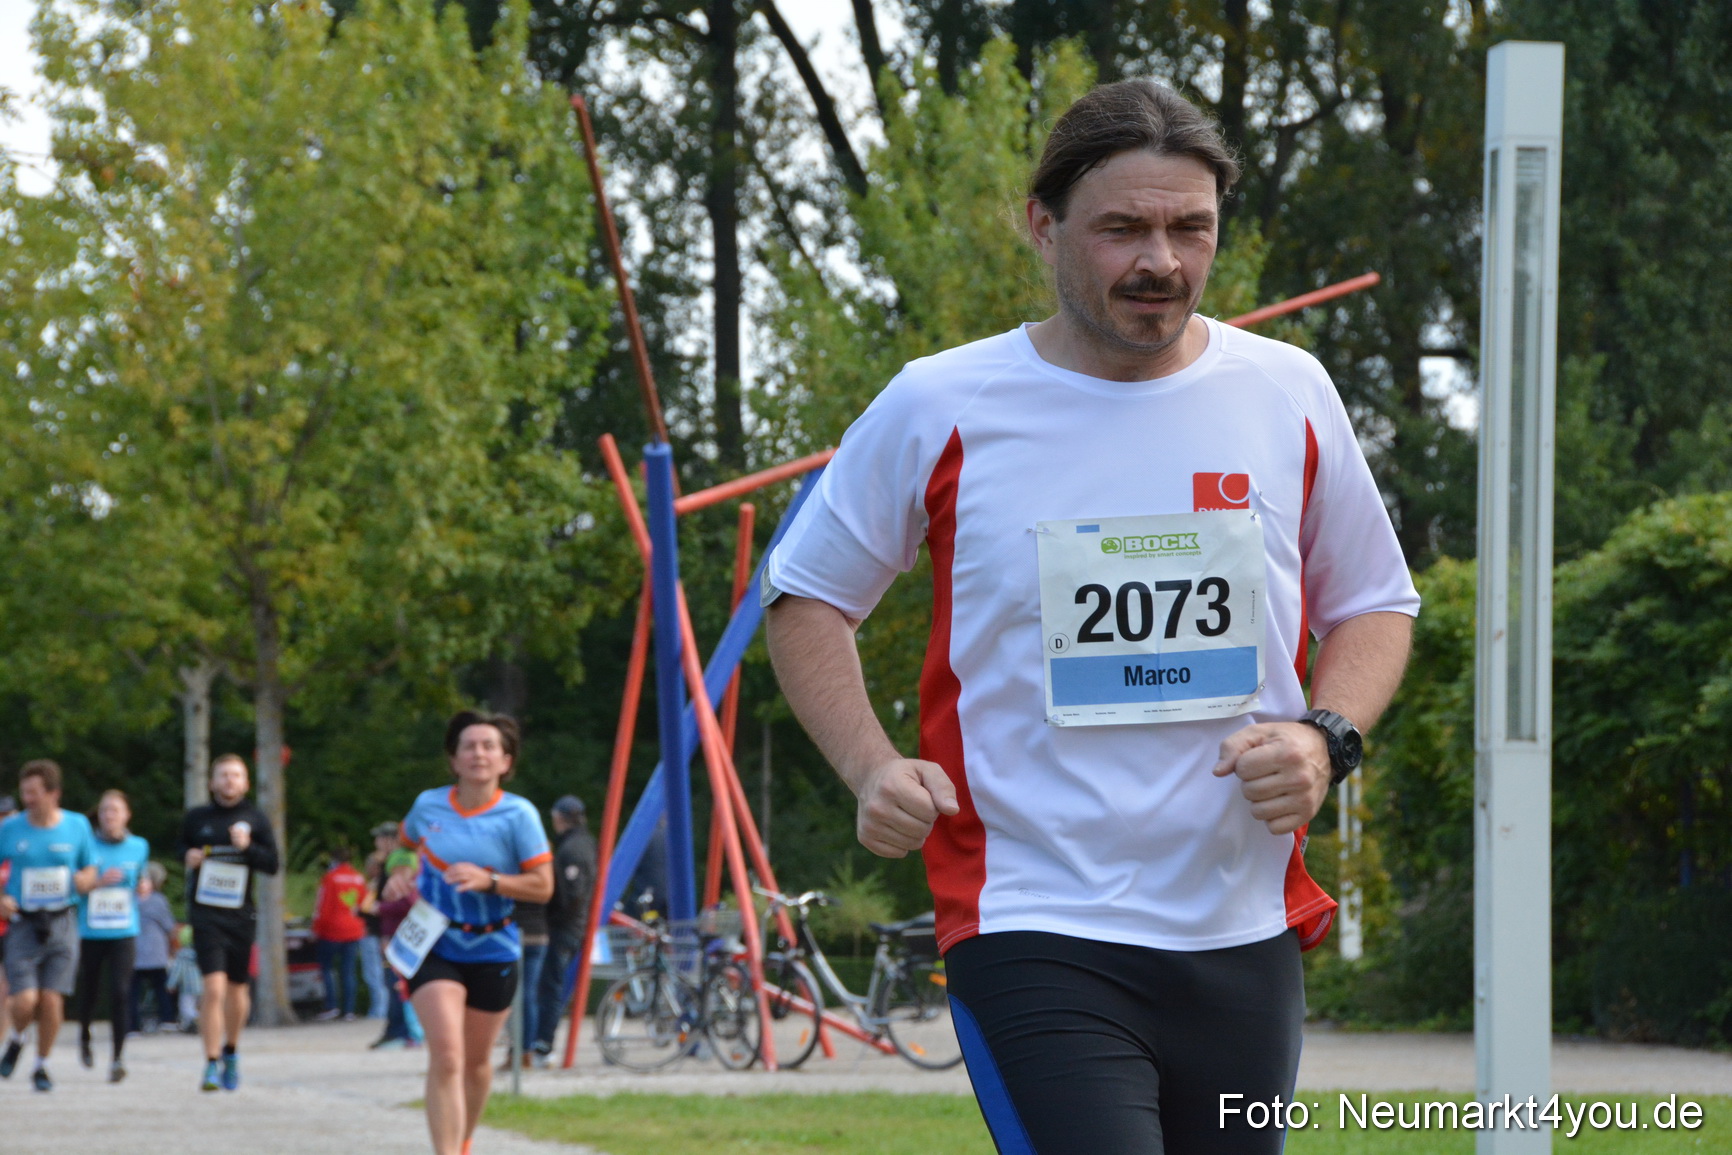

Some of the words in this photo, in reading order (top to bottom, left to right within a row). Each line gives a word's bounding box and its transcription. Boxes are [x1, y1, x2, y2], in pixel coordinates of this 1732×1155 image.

[1123, 533, 1200, 553] BOCK
[1124, 552, 1147, 560] inspired
[1175, 550, 1202, 558] concepts
[1074, 576, 1231, 644] 2073
[1055, 638, 1063, 649] D
[1123, 665, 1191, 687] Marco
